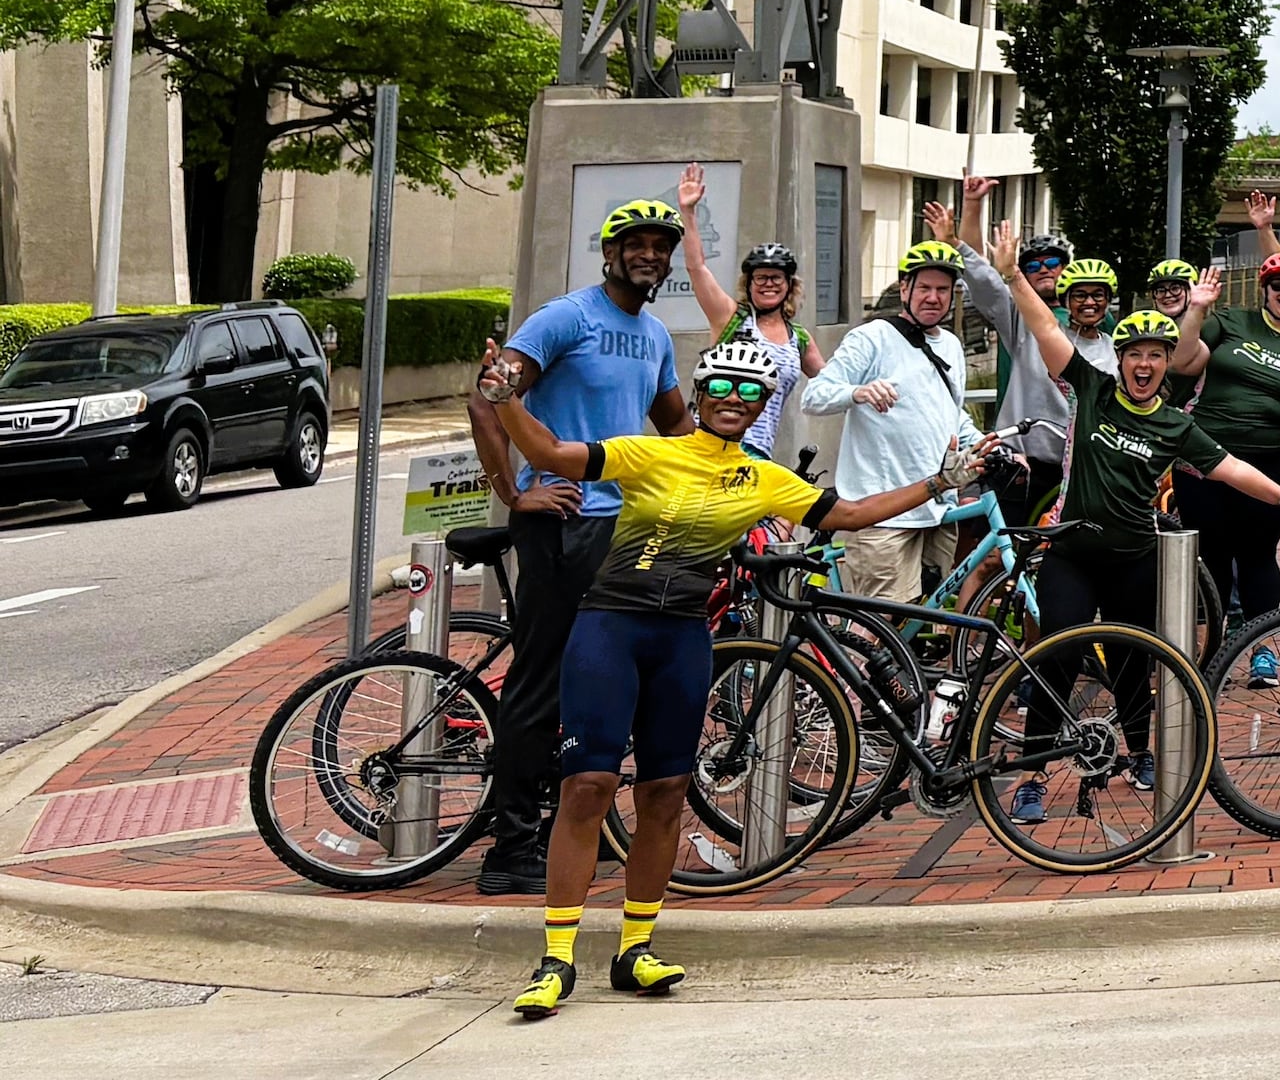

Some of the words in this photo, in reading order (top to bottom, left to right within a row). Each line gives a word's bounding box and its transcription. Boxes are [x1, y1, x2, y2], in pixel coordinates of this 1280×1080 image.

[666, 278, 694, 292] Tra
[659, 479, 691, 523] Alaba
[655, 523, 672, 538] of
[935, 557, 971, 604] FELT
